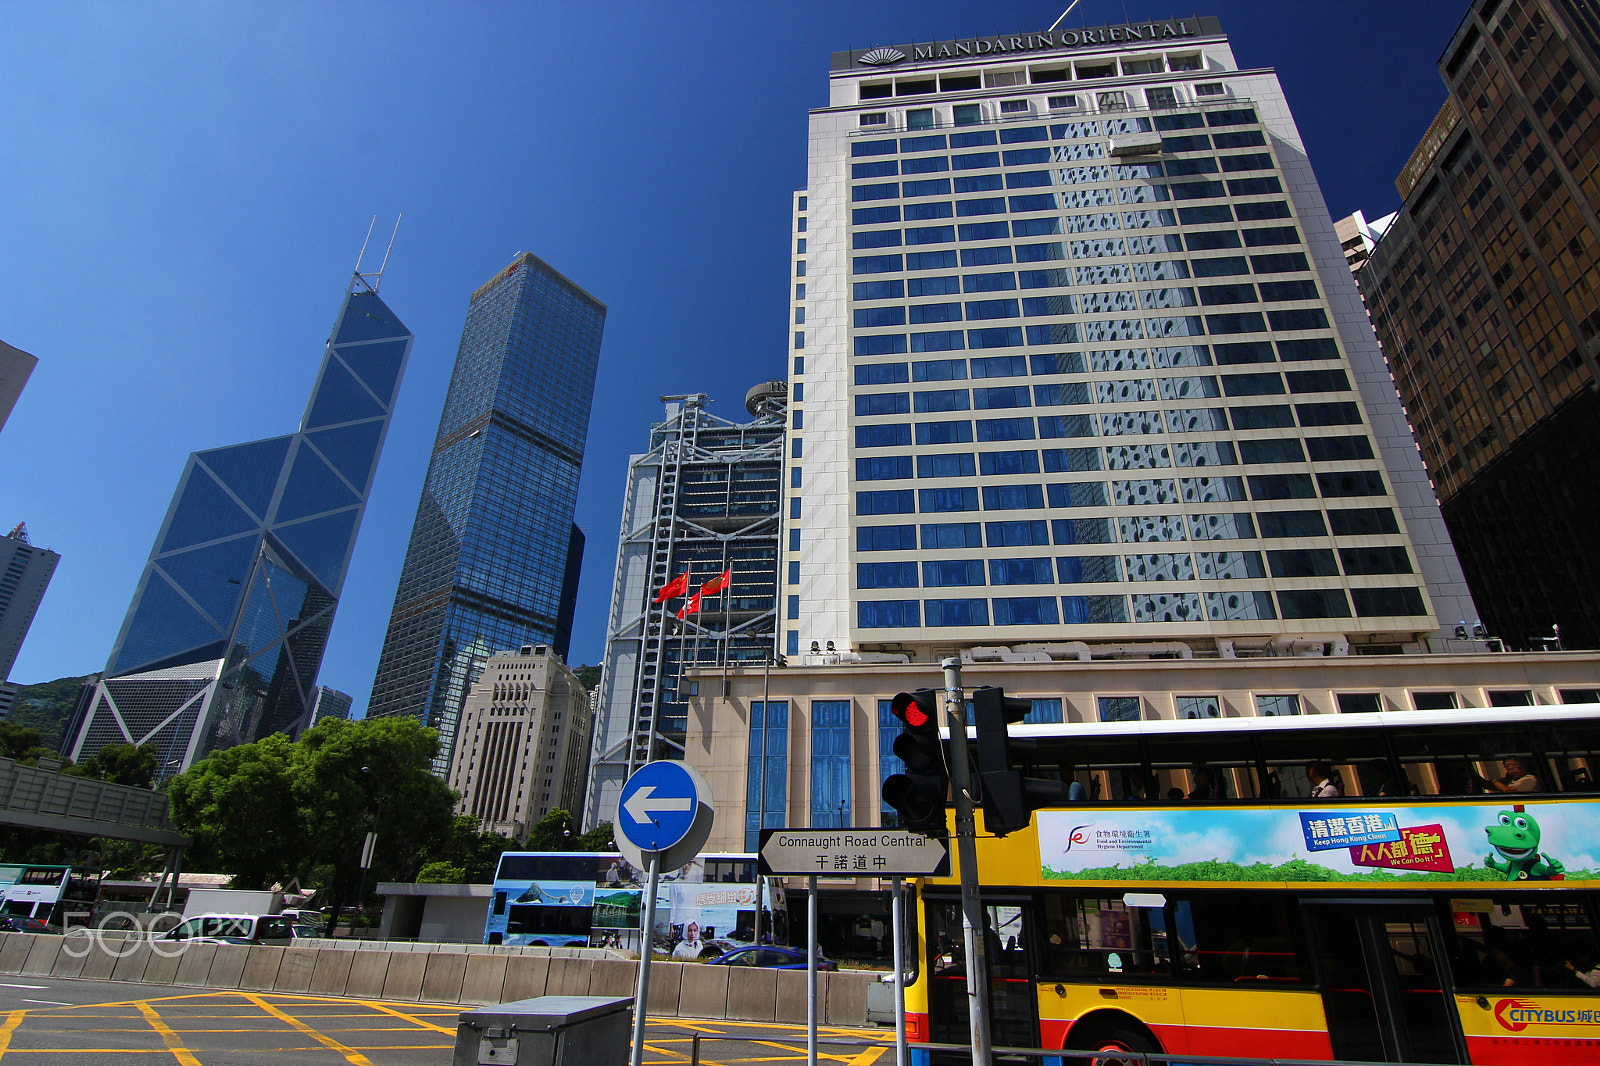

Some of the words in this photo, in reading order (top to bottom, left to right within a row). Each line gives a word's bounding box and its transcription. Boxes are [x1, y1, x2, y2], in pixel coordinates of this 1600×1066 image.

[914, 33, 1054, 60] MANDARIN
[1061, 22, 1195, 46] ORIENTAL
[778, 836, 841, 849] Connaught
[844, 835, 877, 847] Road
[881, 835, 926, 847] Central
[815, 854, 887, 870] 干諾道中
[1401, 857, 1414, 865] Can
[1415, 856, 1425, 864] Do
[1509, 1009, 1576, 1023] CITYBUS
